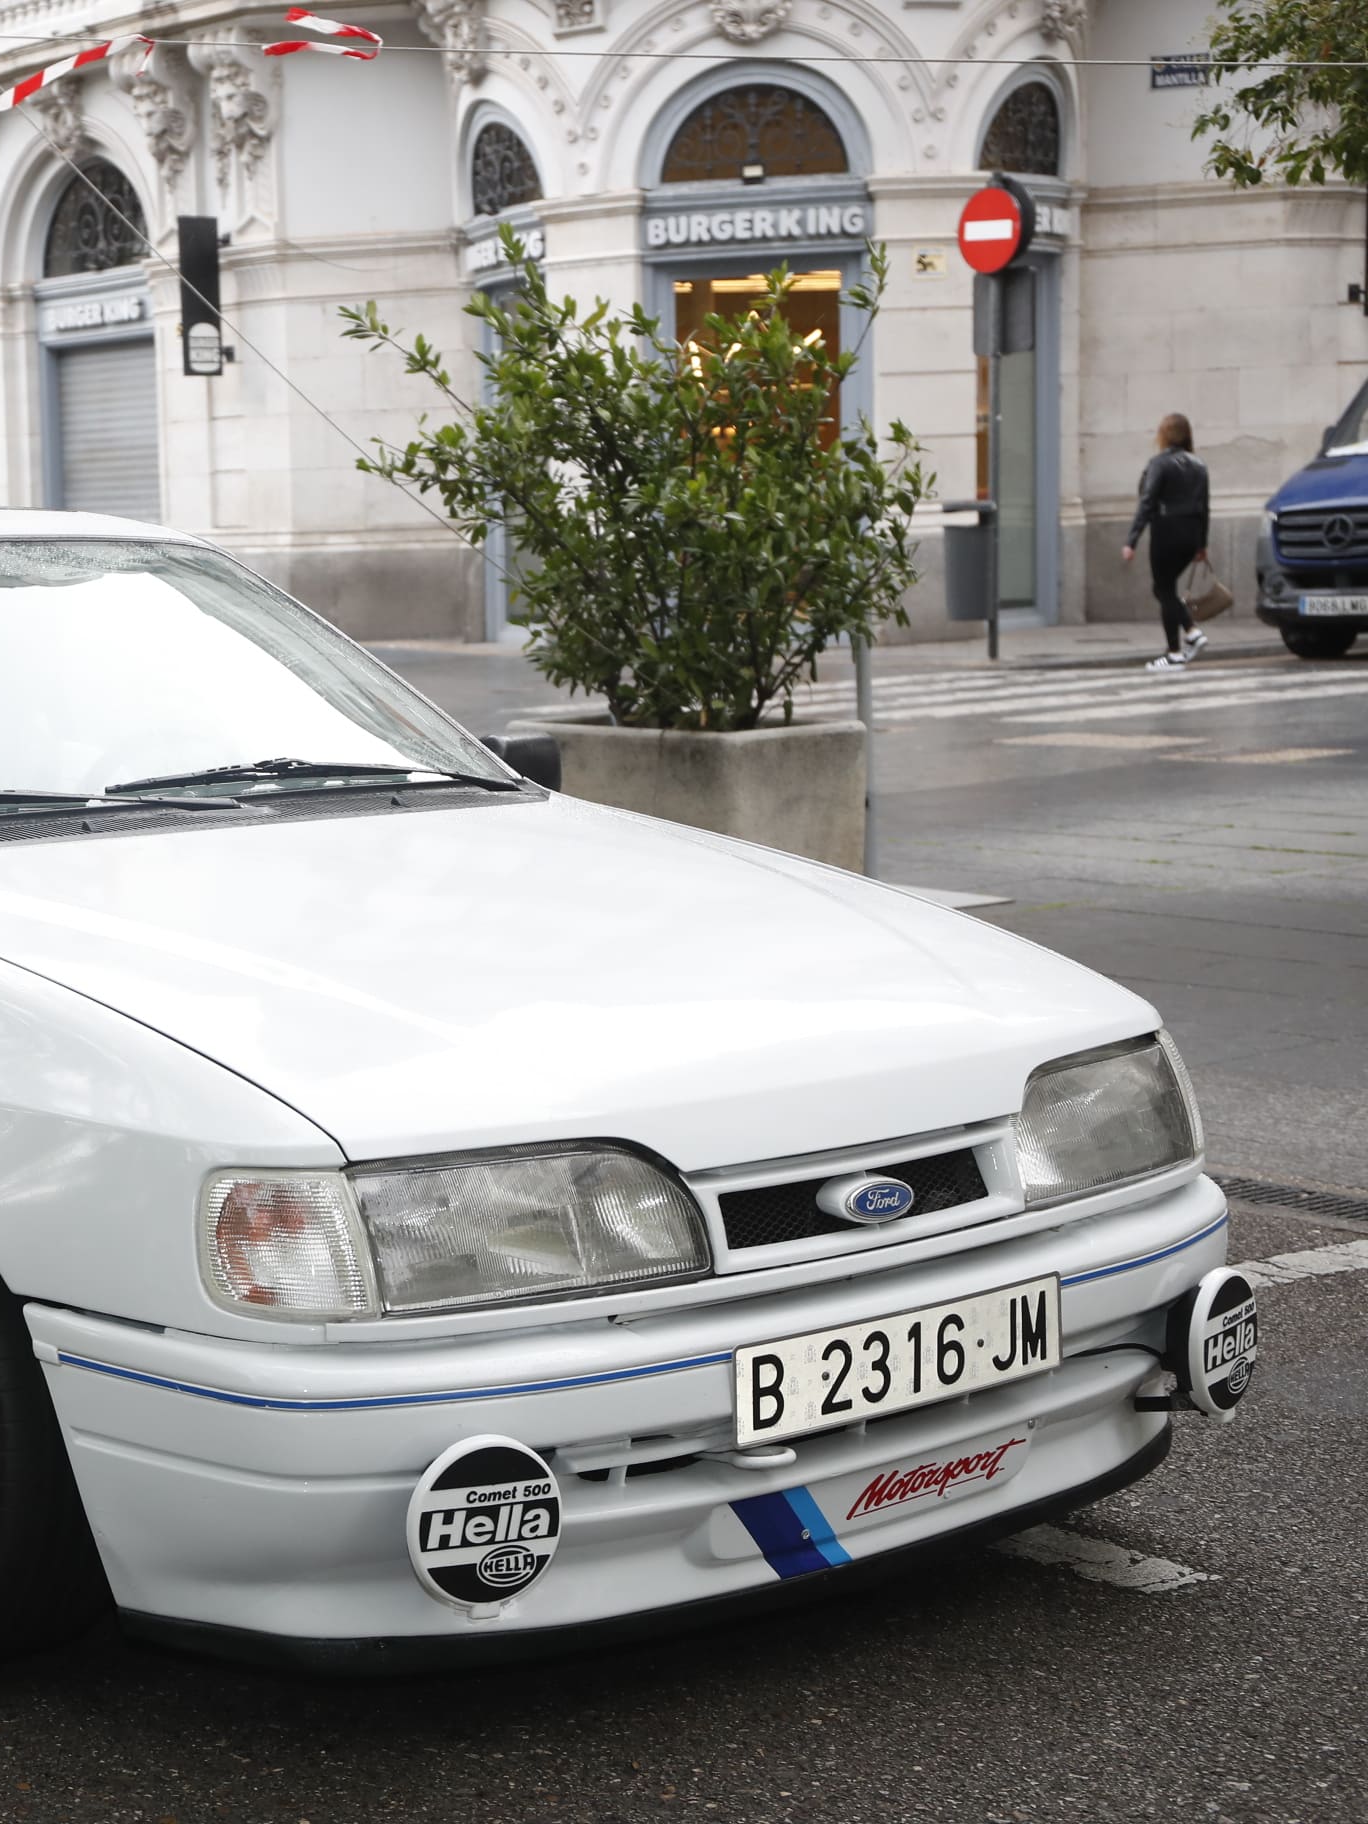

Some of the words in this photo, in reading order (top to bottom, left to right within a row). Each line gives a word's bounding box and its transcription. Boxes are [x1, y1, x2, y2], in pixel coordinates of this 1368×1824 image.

[646, 209, 775, 247] BURGER
[778, 206, 864, 237] KING
[866, 1188, 901, 1210] Ford
[1222, 1308, 1243, 1328] Comet
[752, 1353, 785, 1431] B
[820, 1313, 966, 1416] 2316
[992, 1290, 1048, 1372] JM
[1206, 1320, 1255, 1371] Hella
[466, 1485, 518, 1504] Comet
[522, 1482, 552, 1498] 500
[845, 1437, 1027, 1521] Motorsport
[425, 1503, 551, 1551] Hella
[482, 1552, 535, 1574] HELLA
